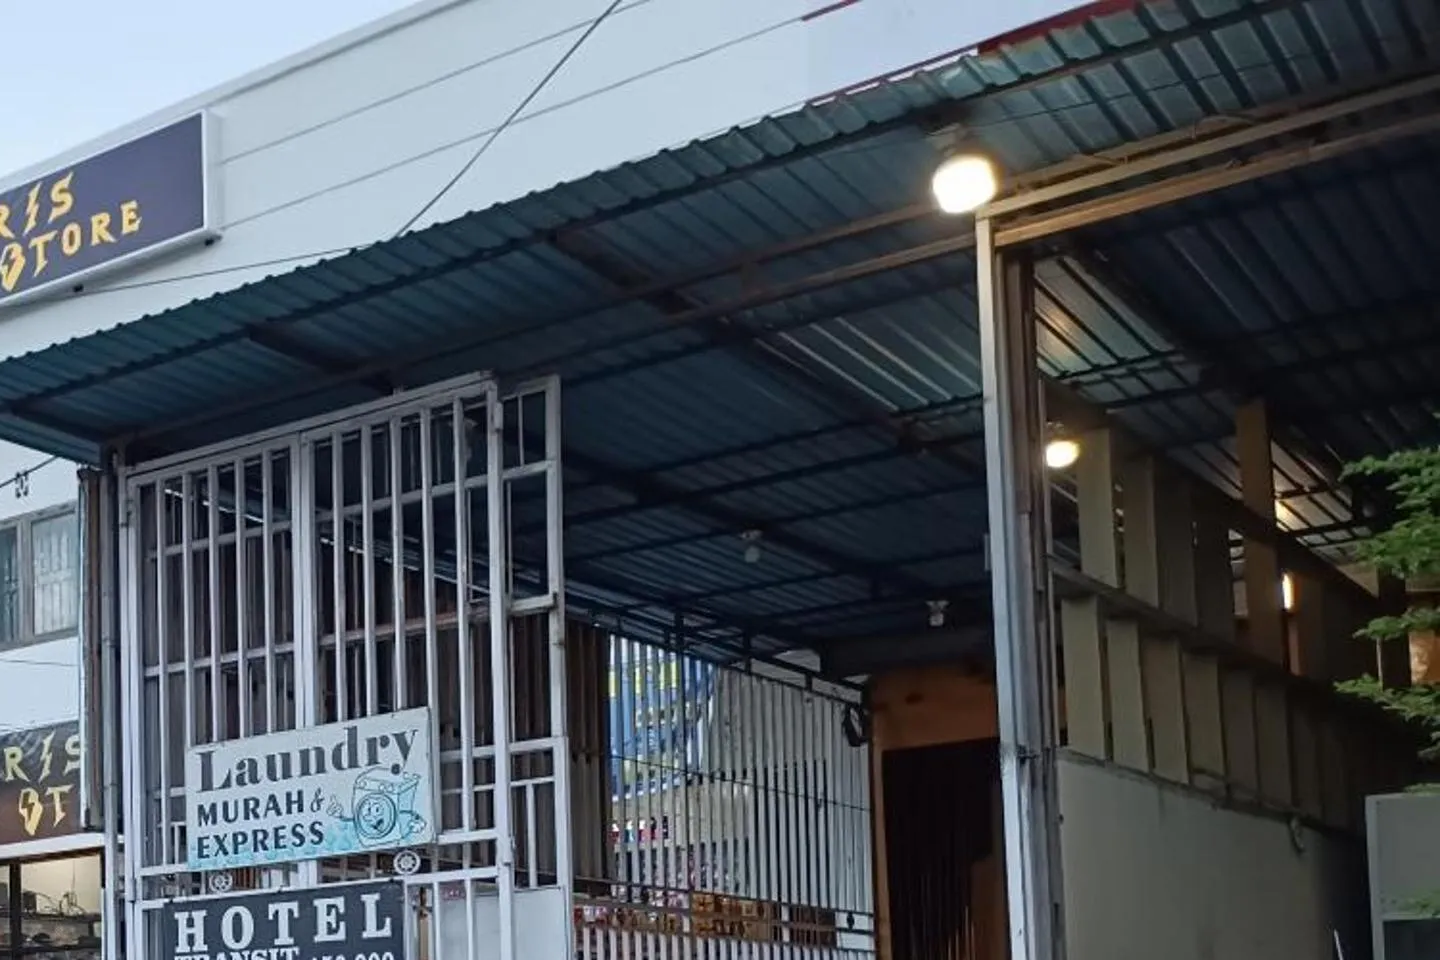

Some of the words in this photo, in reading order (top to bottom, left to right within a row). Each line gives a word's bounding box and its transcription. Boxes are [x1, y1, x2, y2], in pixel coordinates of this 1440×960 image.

[196, 726, 419, 793] Laundry
[197, 789, 305, 828] MURAH
[310, 788, 326, 814] &
[197, 821, 325, 860] EXPRESS
[174, 893, 392, 953] HOTEL
